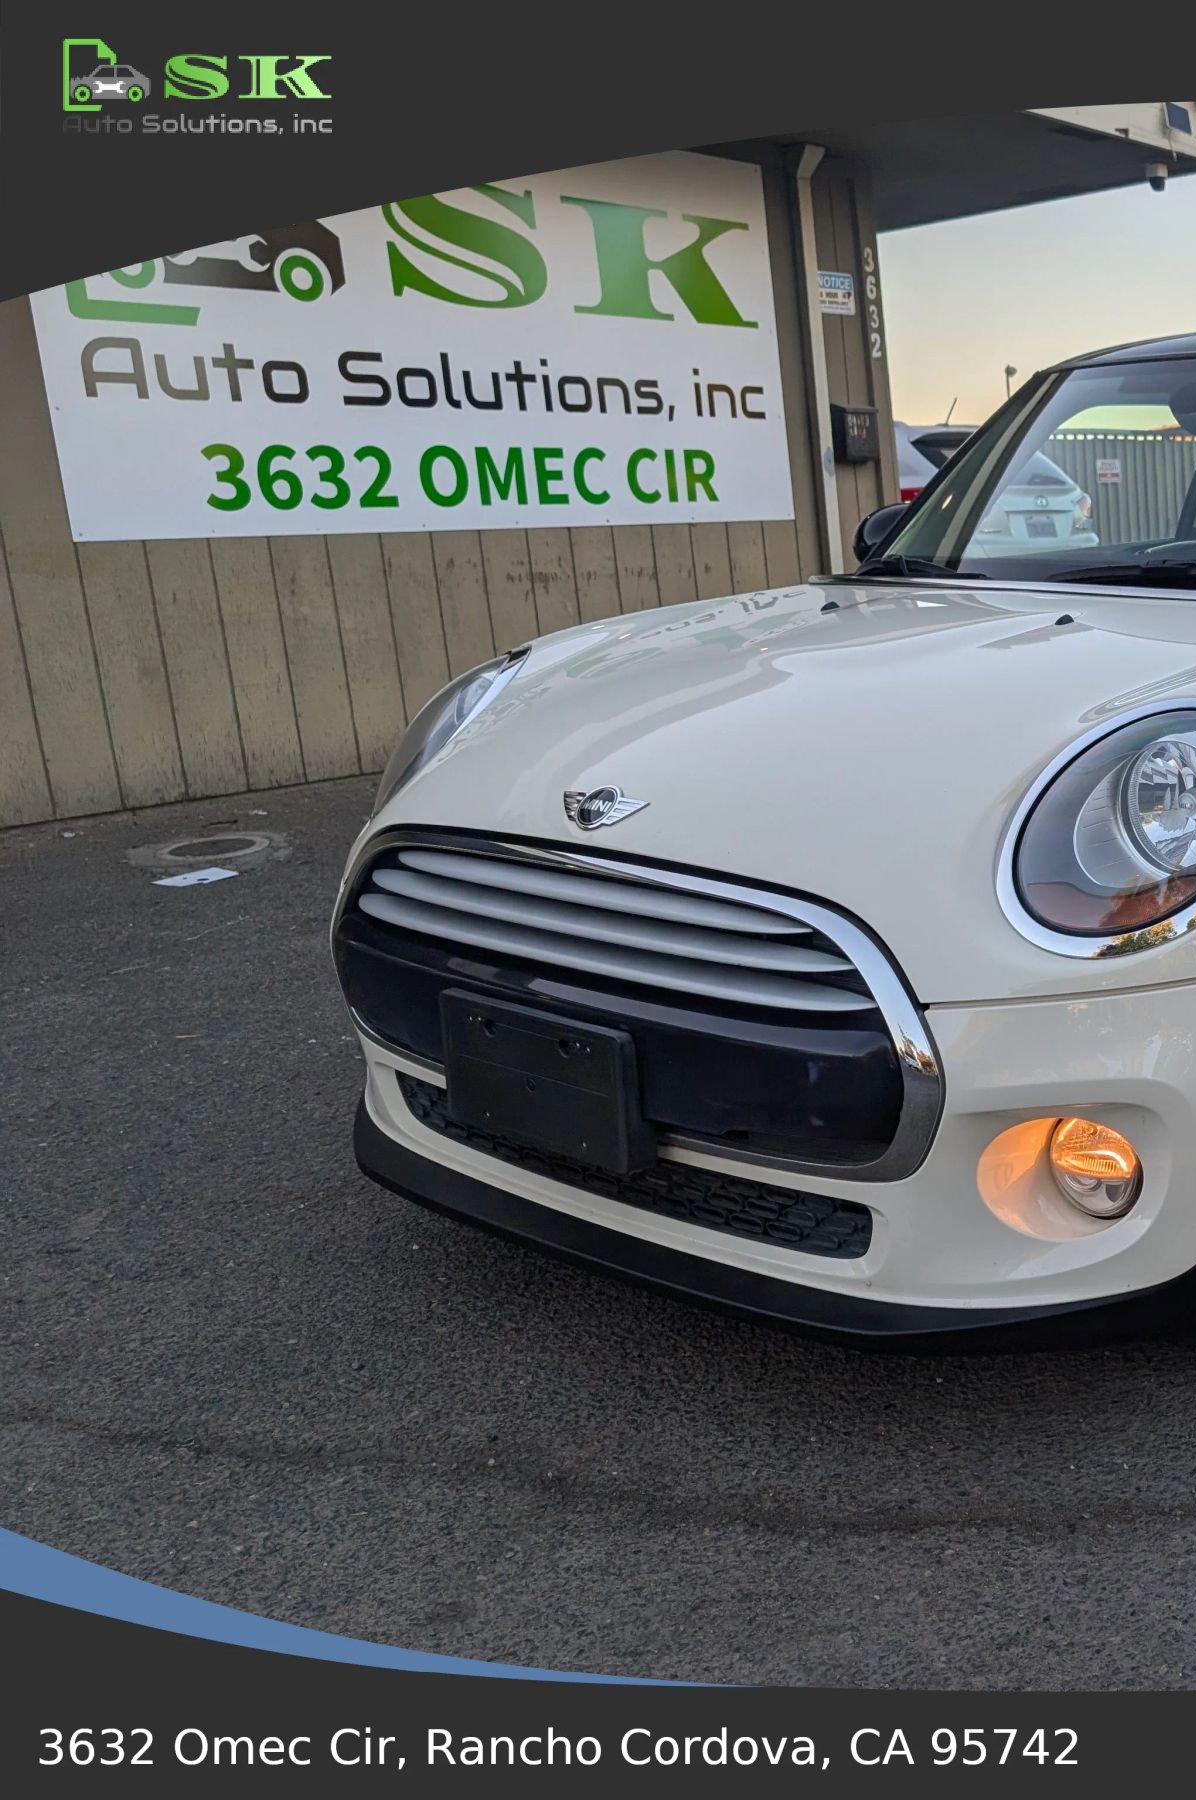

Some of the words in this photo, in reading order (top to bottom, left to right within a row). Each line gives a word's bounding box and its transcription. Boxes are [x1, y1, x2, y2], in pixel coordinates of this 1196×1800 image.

[381, 183, 760, 329] SK
[863, 247, 882, 358] 3632
[81, 336, 310, 404] Auto
[337, 350, 676, 422] Solutions,
[692, 367, 767, 420] inc
[201, 443, 399, 511] 3632
[419, 444, 611, 507] OMEC
[626, 447, 720, 503] CIR
[582, 799, 613, 812] MINI
